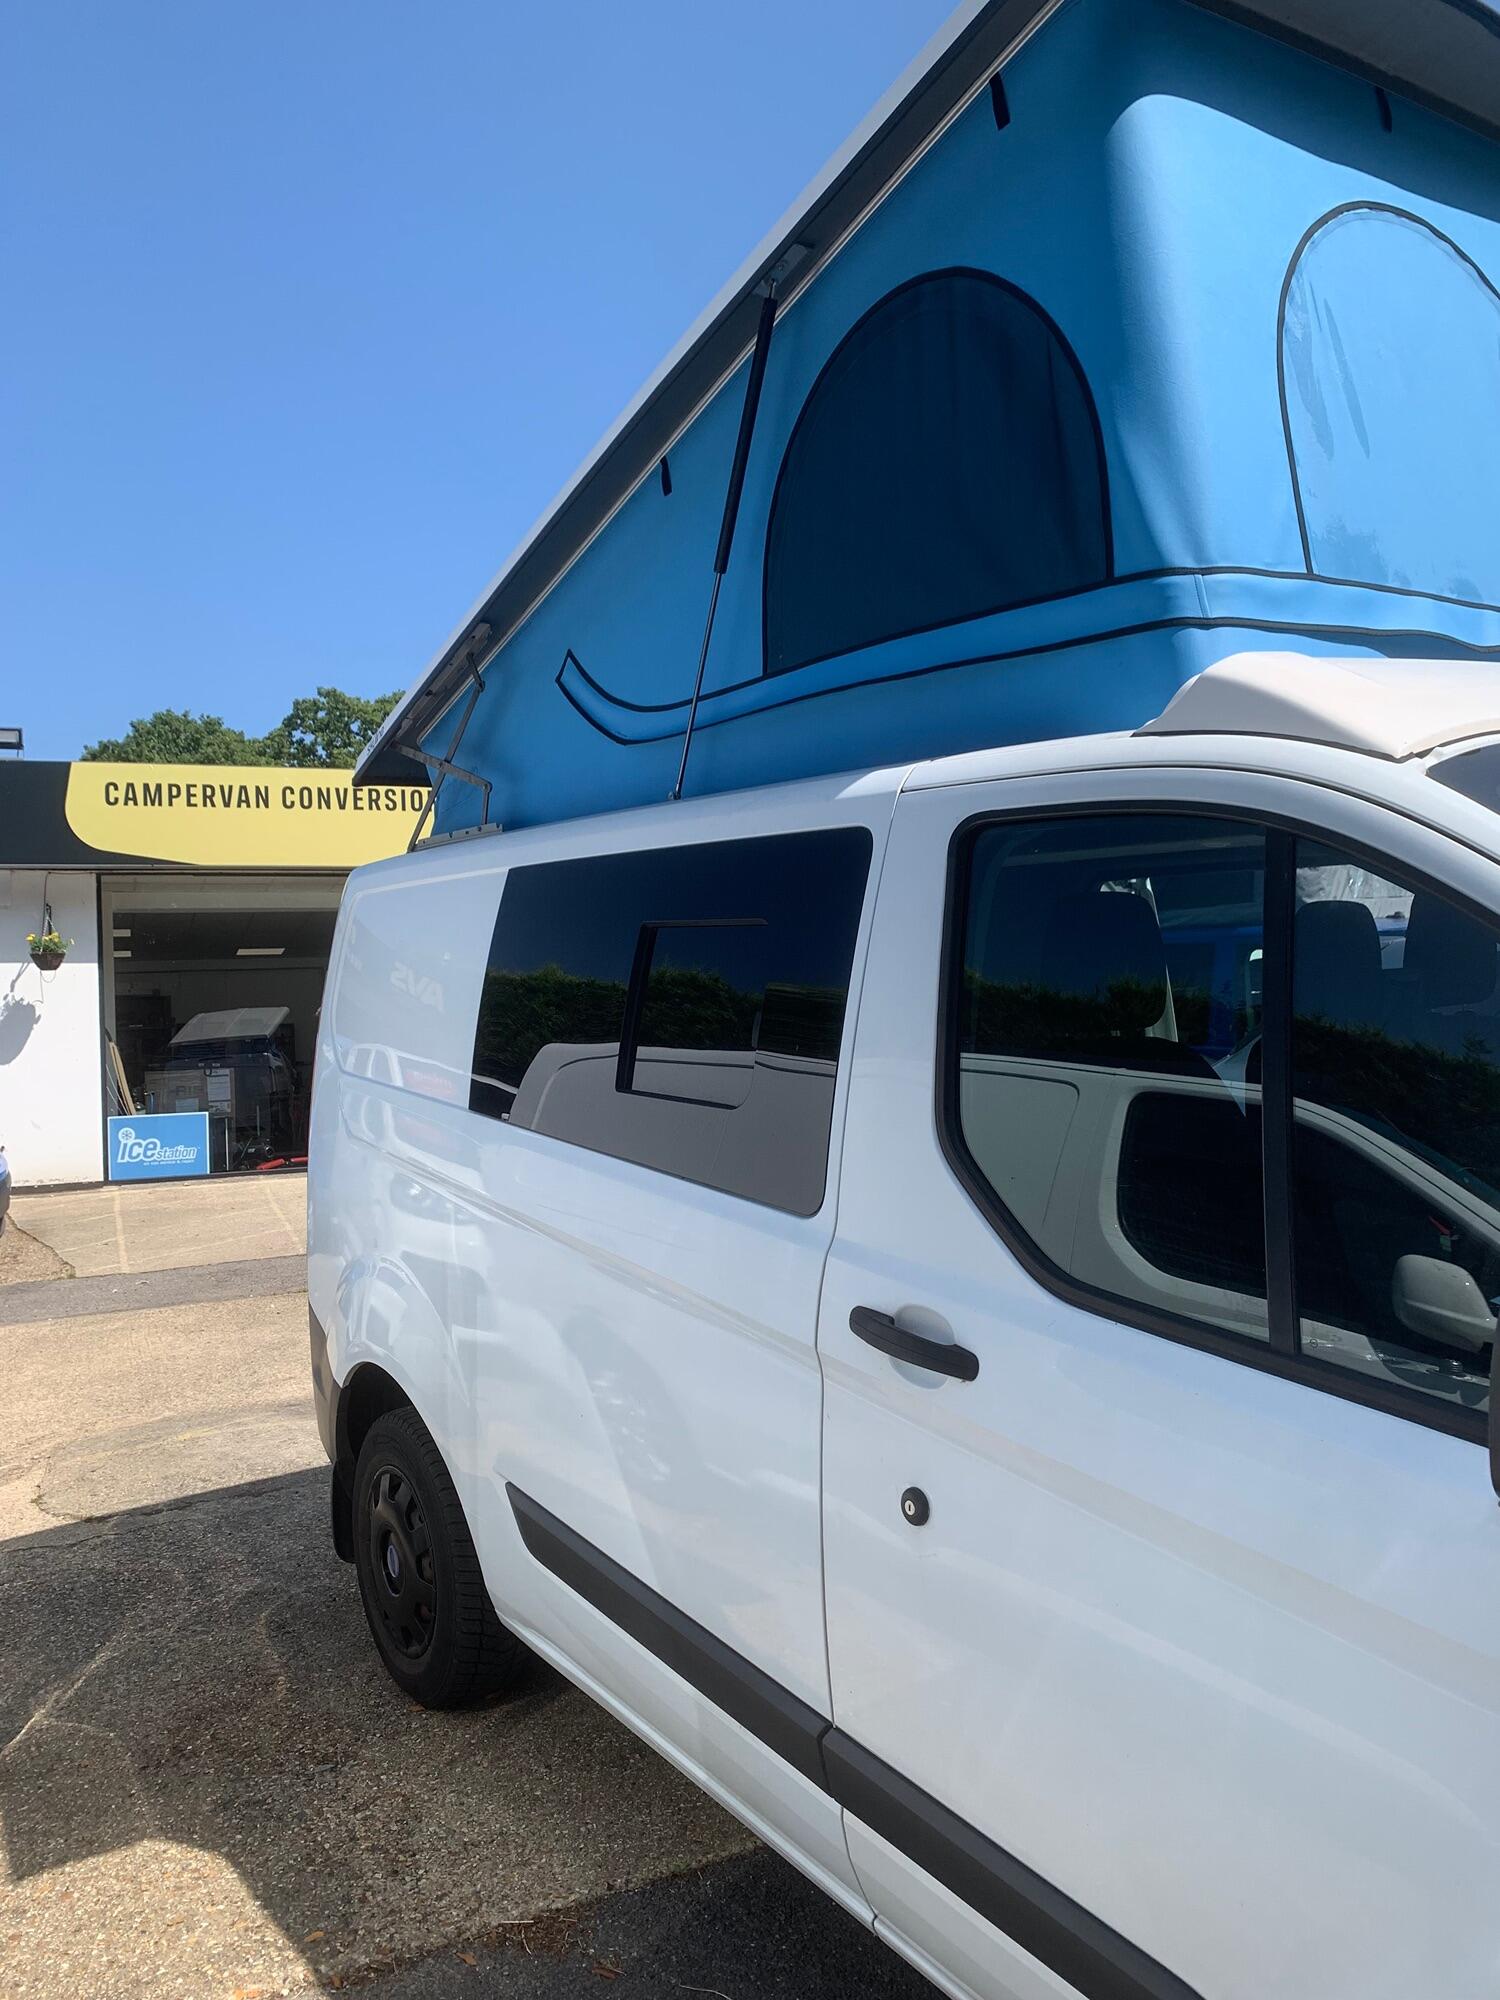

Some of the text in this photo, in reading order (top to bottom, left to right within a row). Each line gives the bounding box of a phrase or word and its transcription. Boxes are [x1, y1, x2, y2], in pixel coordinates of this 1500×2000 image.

[105, 781, 432, 812] CAMPERVAN CONVERSIO
[156, 1145, 197, 1160] station
